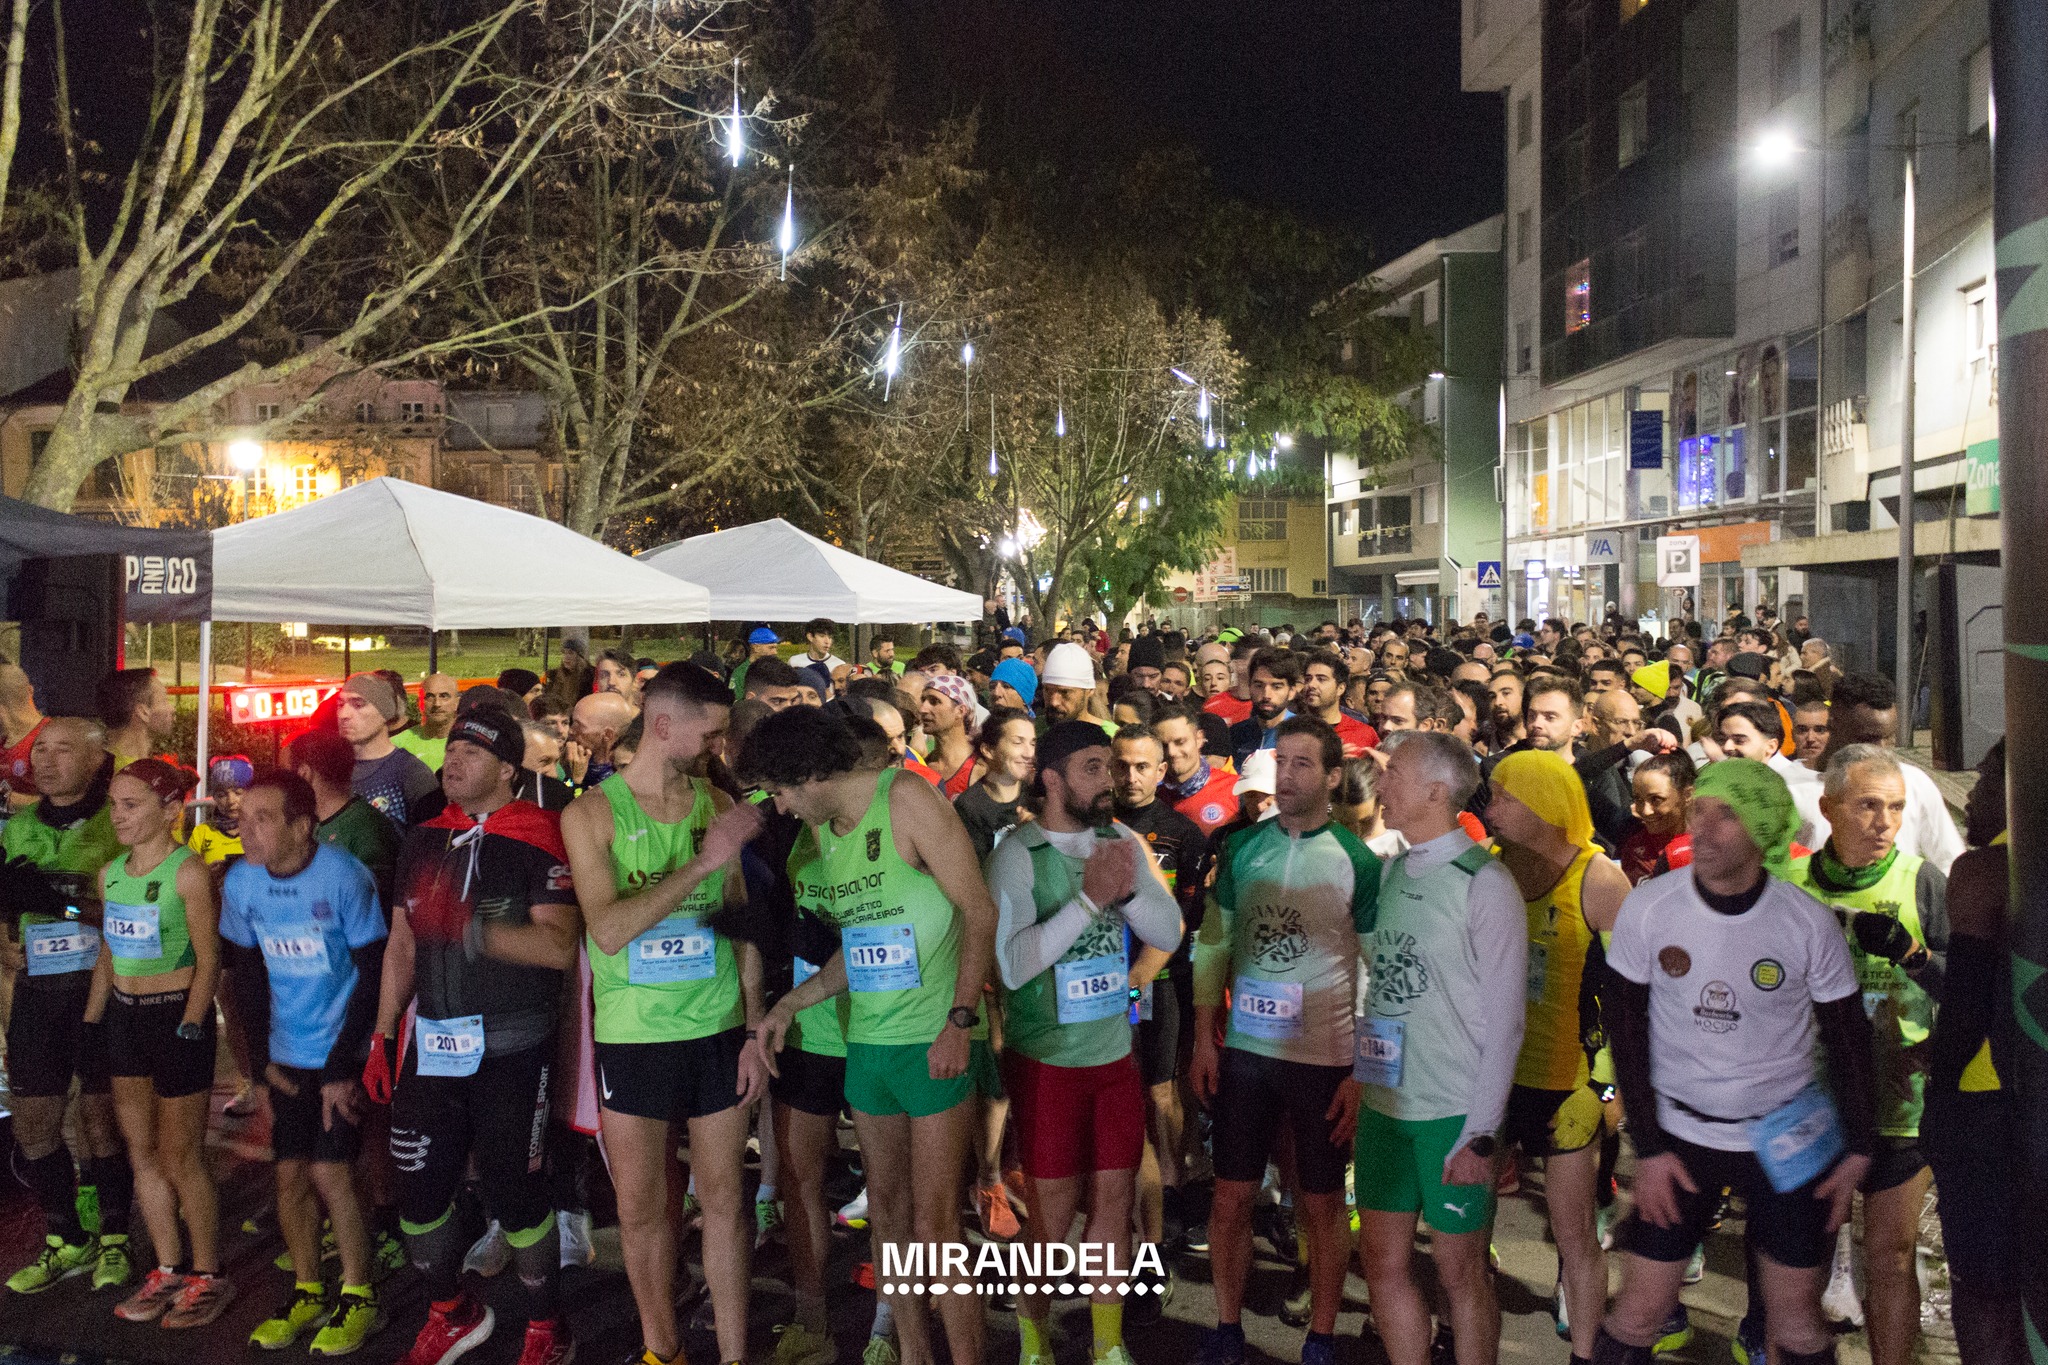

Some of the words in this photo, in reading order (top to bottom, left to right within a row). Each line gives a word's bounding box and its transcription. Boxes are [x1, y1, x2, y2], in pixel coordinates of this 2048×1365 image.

[141, 556, 165, 595] AND
[167, 556, 198, 595] GO
[113, 921, 135, 935] 134
[49, 938, 70, 953] 22
[661, 938, 685, 956] 92
[858, 947, 888, 965] 119
[1081, 976, 1109, 995] 186
[140, 996, 162, 1006] NIKE
[164, 992, 184, 1002] PRO
[1249, 997, 1277, 1015] 182
[436, 1035, 458, 1052] 201
